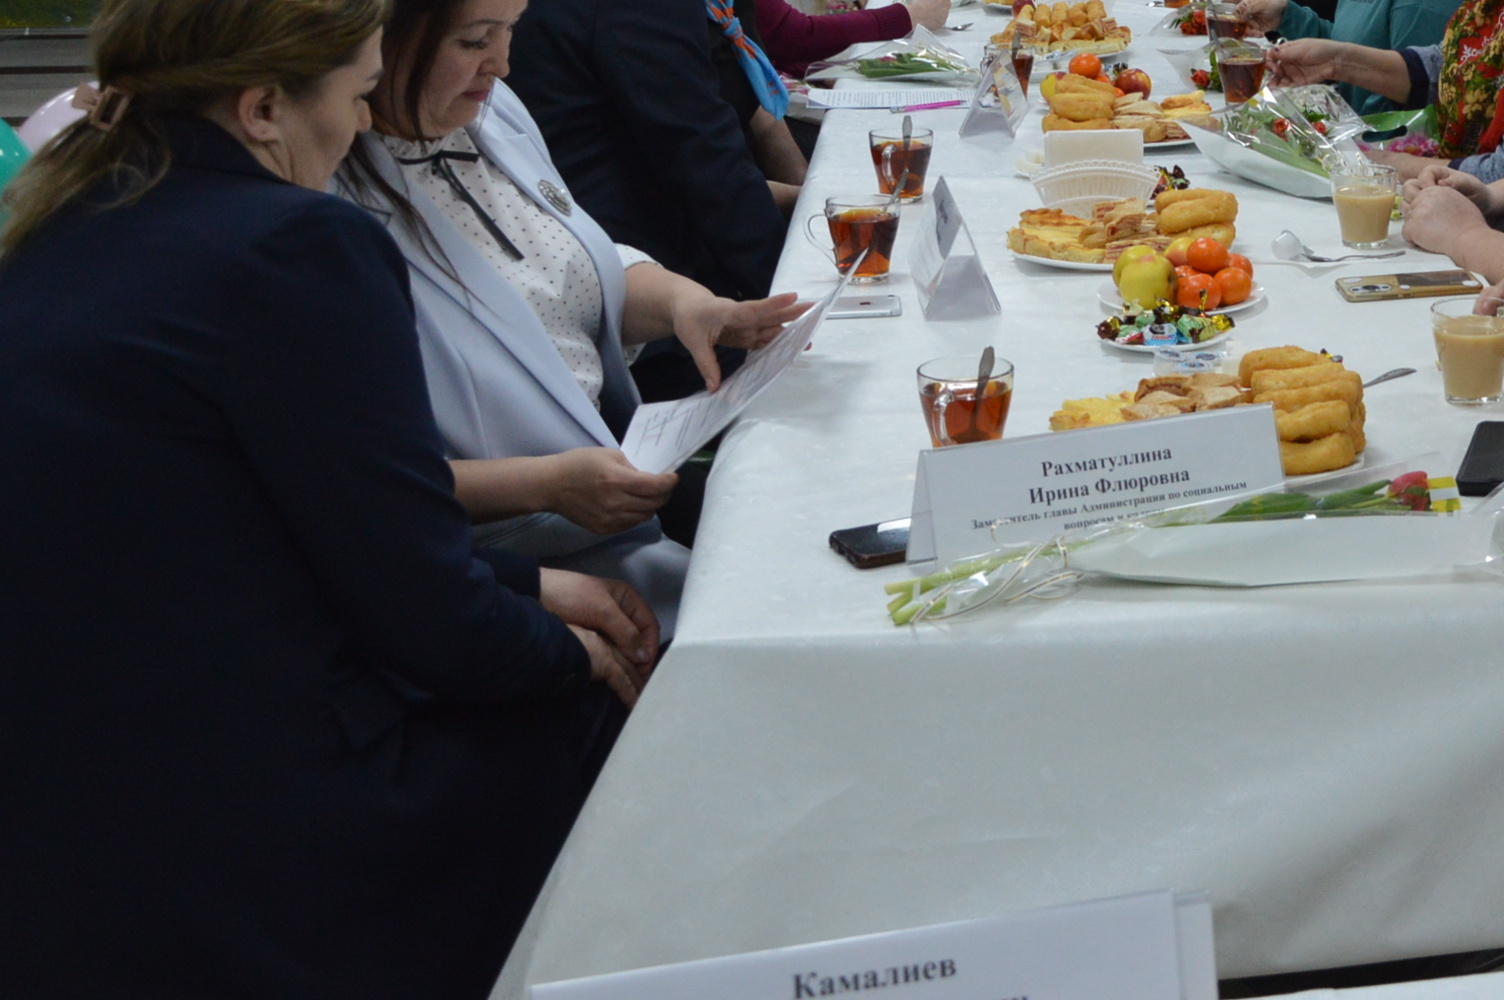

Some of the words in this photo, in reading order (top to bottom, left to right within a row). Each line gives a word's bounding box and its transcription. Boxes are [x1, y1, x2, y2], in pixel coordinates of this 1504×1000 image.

[1040, 447, 1173, 478] Рахматуллина
[1028, 484, 1090, 506] Ирина
[1095, 469, 1191, 495] Флюровна
[1043, 505, 1078, 521] главы
[1080, 493, 1166, 514] Администрации
[1168, 490, 1182, 501] по
[1182, 480, 1248, 499] социальным
[792, 957, 958, 1000] Камалиев
